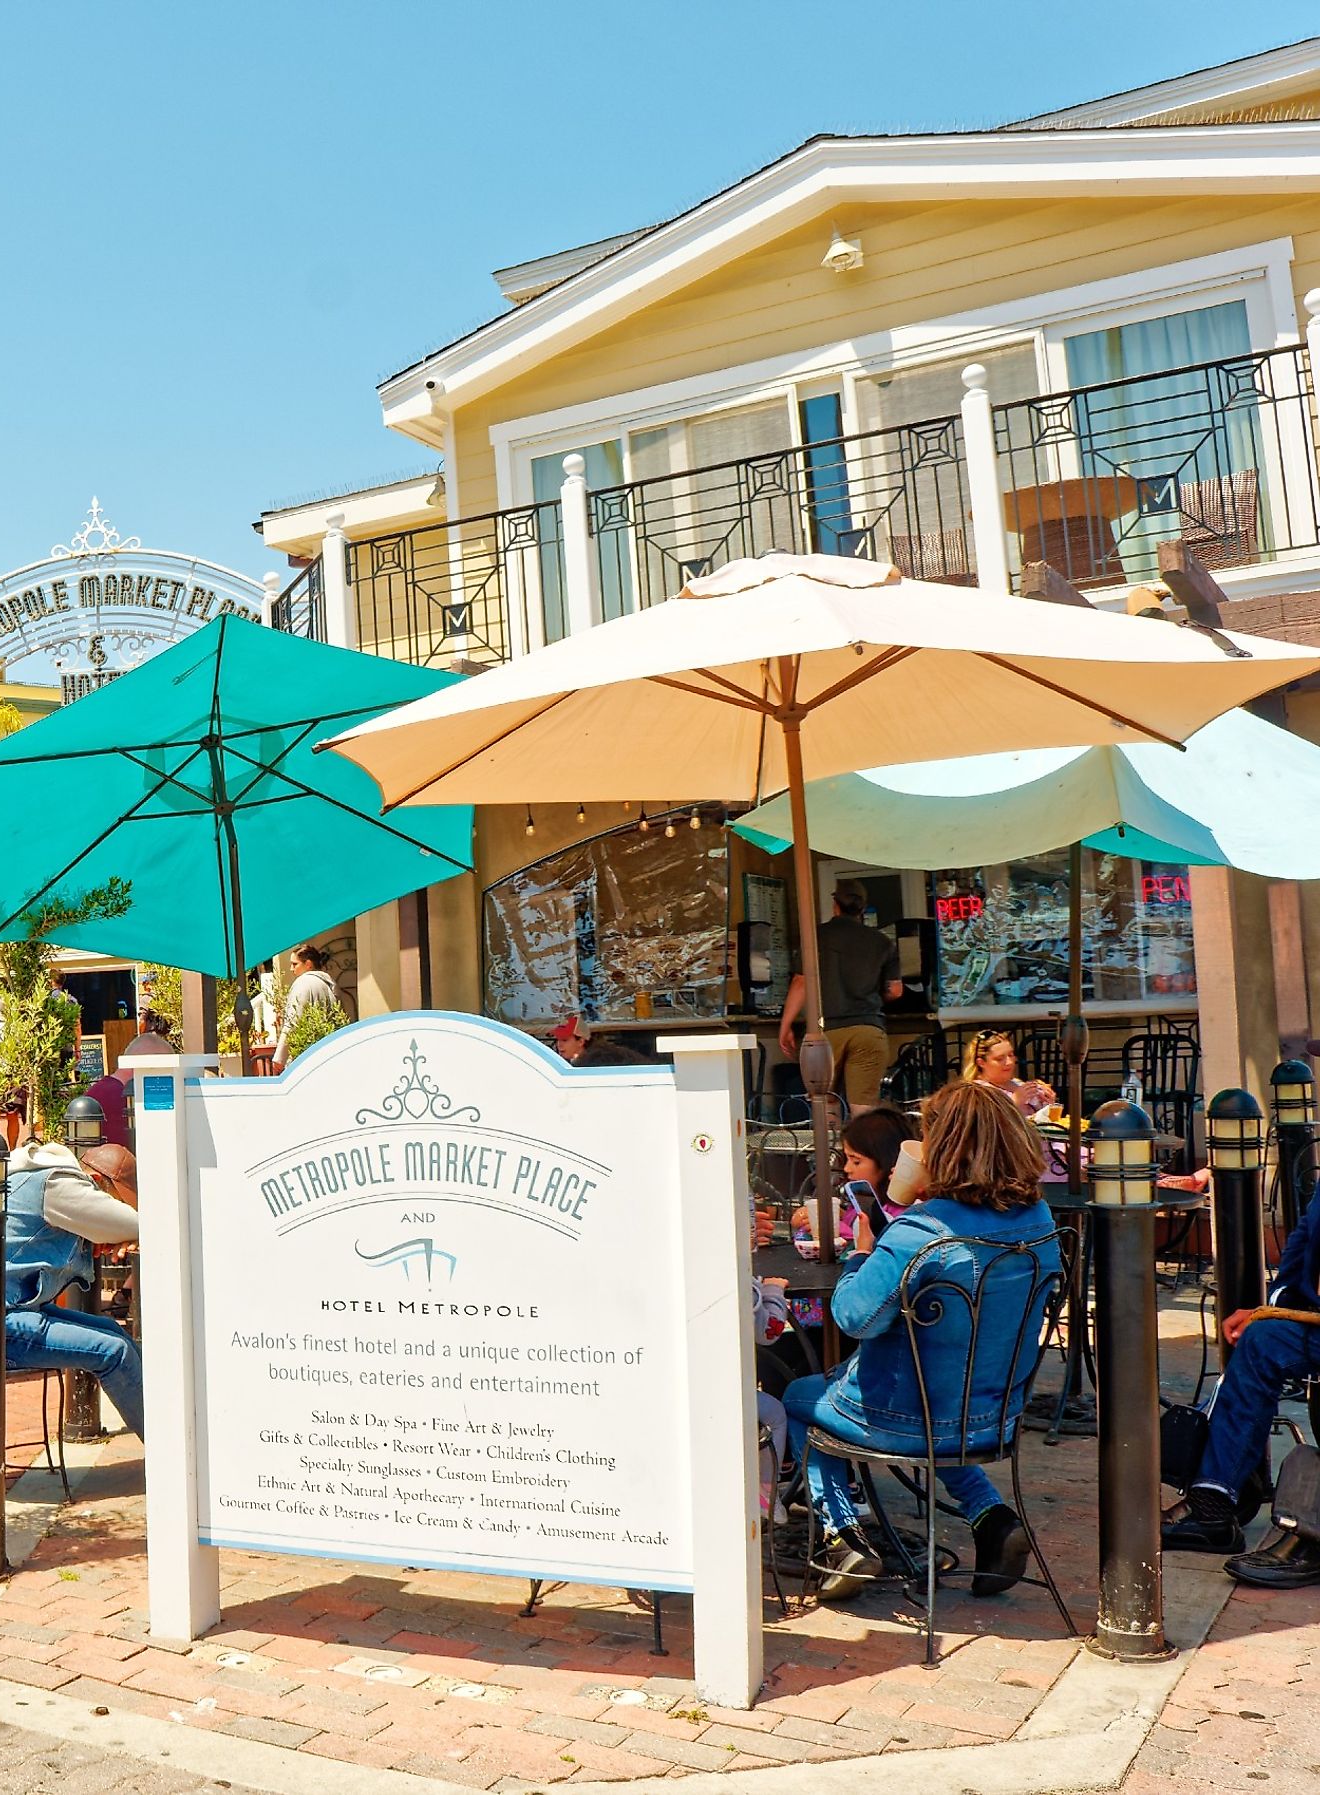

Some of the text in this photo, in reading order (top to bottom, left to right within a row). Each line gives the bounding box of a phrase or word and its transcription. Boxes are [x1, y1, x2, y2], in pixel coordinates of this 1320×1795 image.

[80, 574, 185, 609] MARKET
[1142, 874, 1192, 904] PEN
[260, 1141, 597, 1221] METROPOLE MARKET PLACE
[400, 1212, 436, 1224] AND
[321, 1300, 540, 1318] HOTEL METROPOLE
[231, 1331, 645, 1366] Avalon's finest hotel and a unique collection of
[269, 1362, 601, 1397] boutiques, eateries and entertainment
[311, 1410, 555, 1442] Salon & Day Spa Fine Art & Jewelry
[259, 1430, 616, 1471] Gifts & Collectibles Resort Wear Children's Clothing
[299, 1456, 571, 1493] Specialty Sunglasses Custom Embroidery
[258, 1475, 621, 1517] Ethnic Art & Natural Apothecary International Cuisine
[219, 1494, 669, 1546] Gourmet Coffee & Pastries Ice Cream & Candy Amusement Arcade
